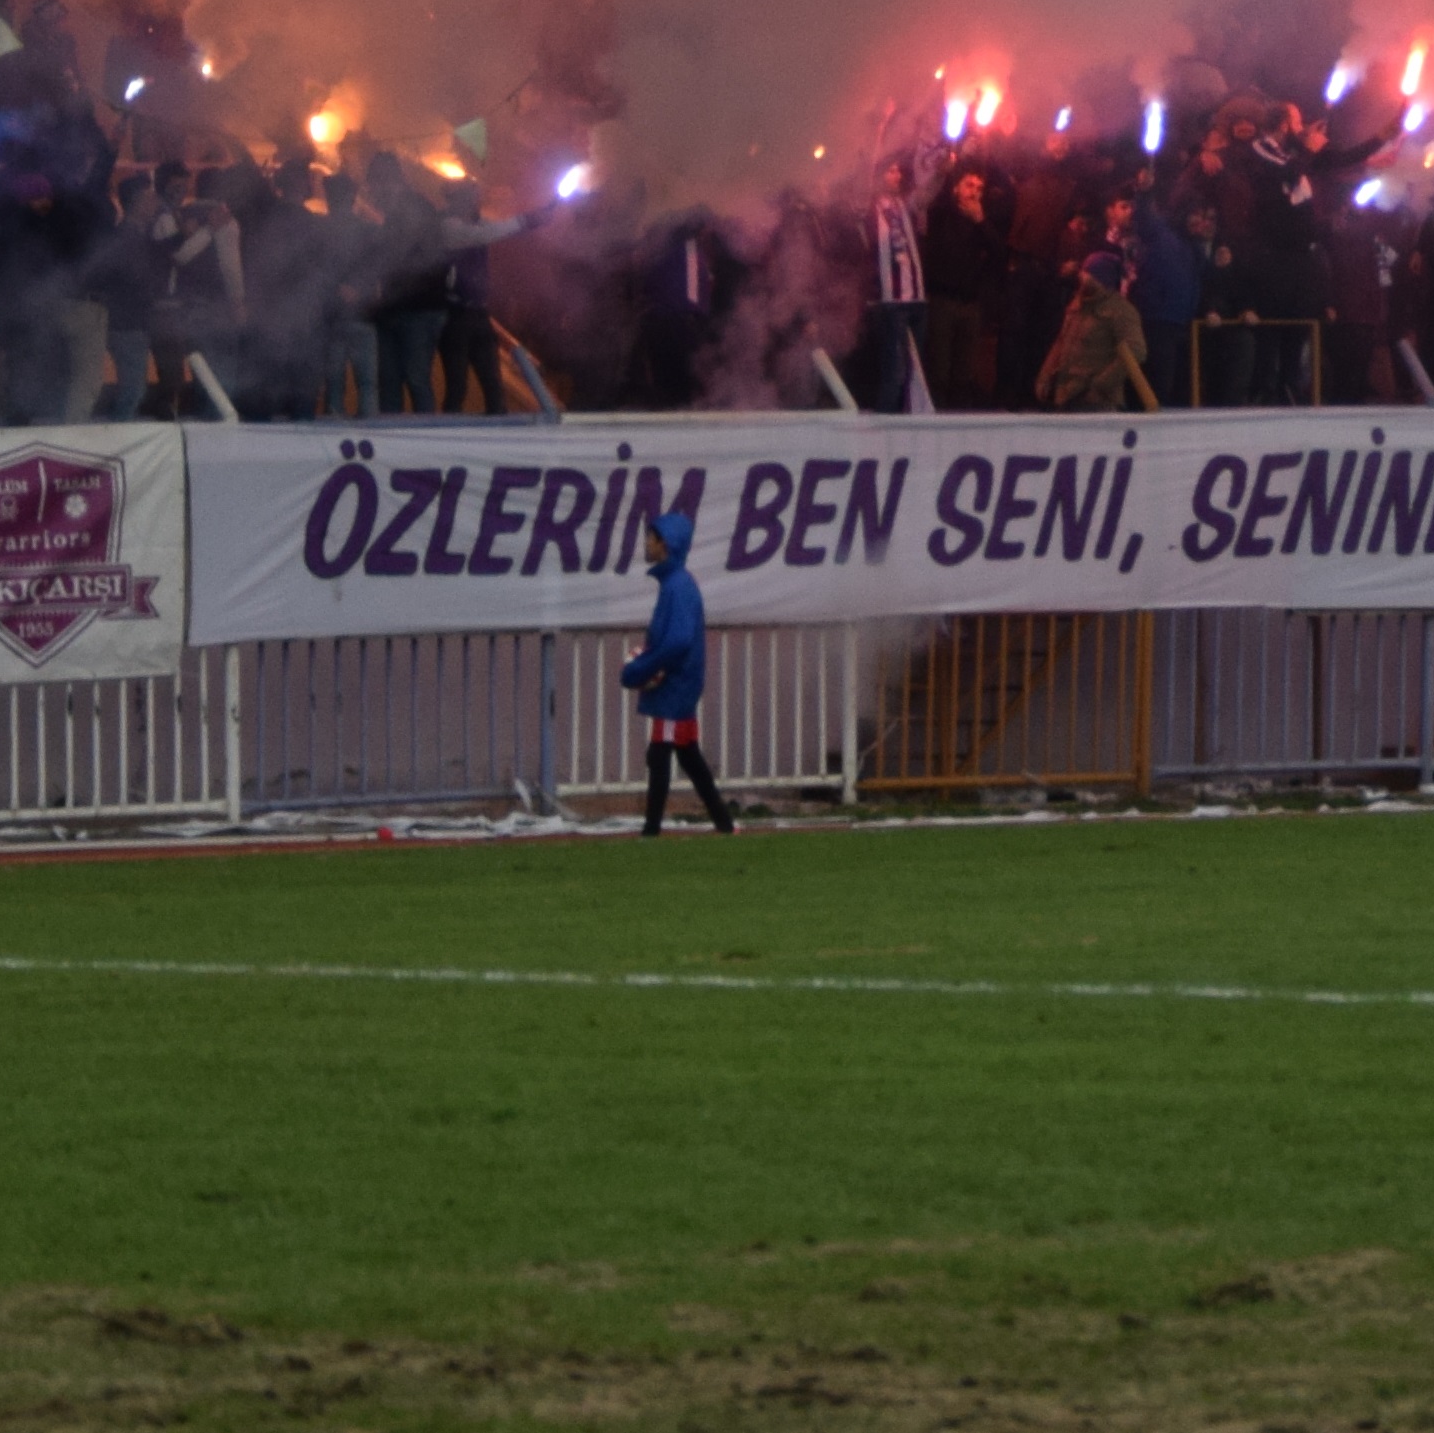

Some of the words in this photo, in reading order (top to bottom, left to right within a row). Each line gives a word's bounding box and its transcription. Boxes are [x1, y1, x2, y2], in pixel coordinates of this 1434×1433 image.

[303, 438, 707, 581] ÖZLERİM
[725, 456, 909, 571] BEN
[928, 429, 1143, 573] SENİ,
